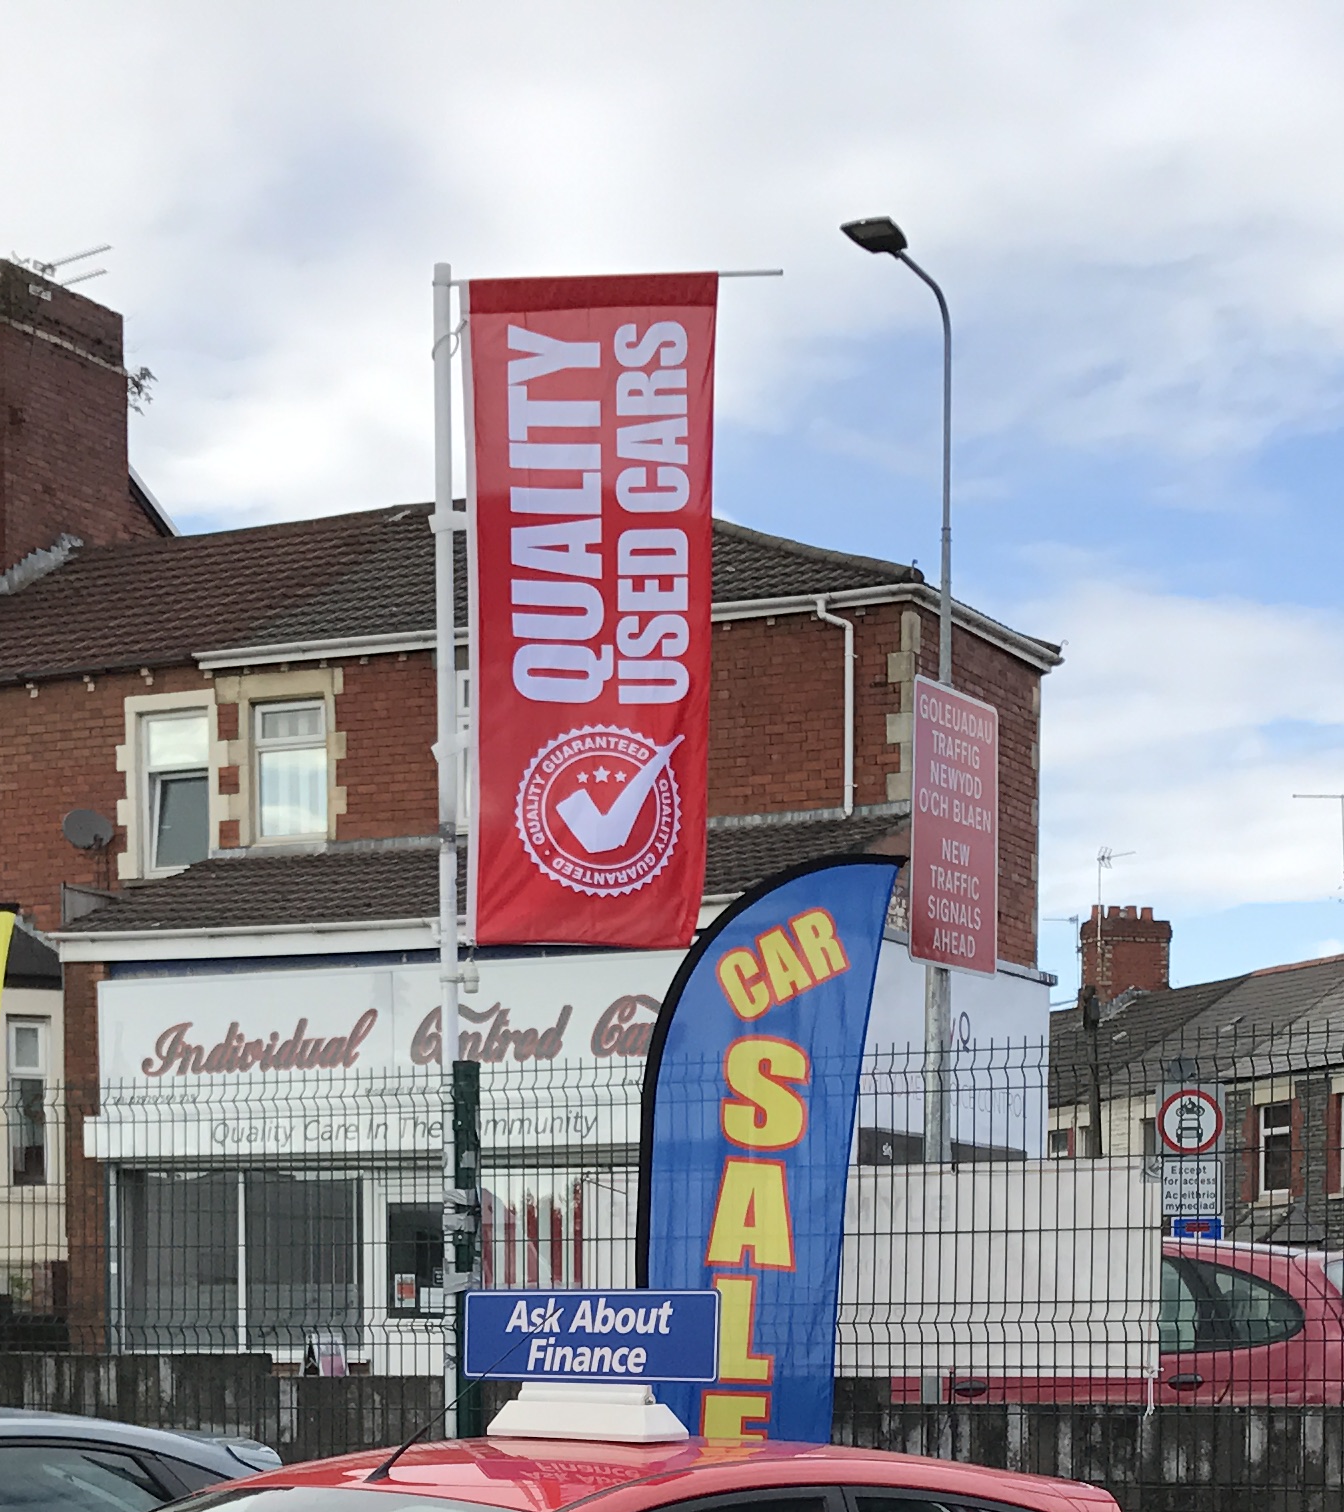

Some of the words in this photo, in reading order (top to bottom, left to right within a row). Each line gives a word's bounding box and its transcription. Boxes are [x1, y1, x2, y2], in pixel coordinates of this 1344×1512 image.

[614, 320, 689, 513] CARS
[507, 324, 614, 704] QUALITY
[616, 527, 690, 704] USED
[919, 694, 993, 745] GOLEUADAU
[932, 730, 980, 769] TRAFFIG
[526, 774, 546, 845] QUALITY
[542, 736, 650, 773] GUARANTEED
[930, 760, 982, 800] NEWYDD
[654, 779, 671, 853] QUALITY
[953, 799, 991, 833] BLAEN
[552, 853, 656, 885] GUARANTEED
[942, 838, 969, 866] NEW
[930, 865, 979, 900] TRAFFIC
[928, 895, 981, 931] SIGNALS
[932, 928, 976, 958] AHEAD
[717, 907, 850, 1022] CAR
[141, 1008, 379, 1078] Individual
[410, 1001, 573, 1066] Cntred
[590, 994, 661, 1058] Ca
[212, 1120, 295, 1148] Quality
[305, 1119, 358, 1142] Care
[366, 1117, 389, 1140] In
[400, 1115, 443, 1138] The
[478, 1110, 597, 1139] mmunity
[1164, 1177, 1179, 1185] for
[1165, 1190, 1179, 1200] Ac
[505, 1299, 564, 1335] Ask
[569, 1299, 674, 1336] About
[525, 1339, 646, 1374] Finance
